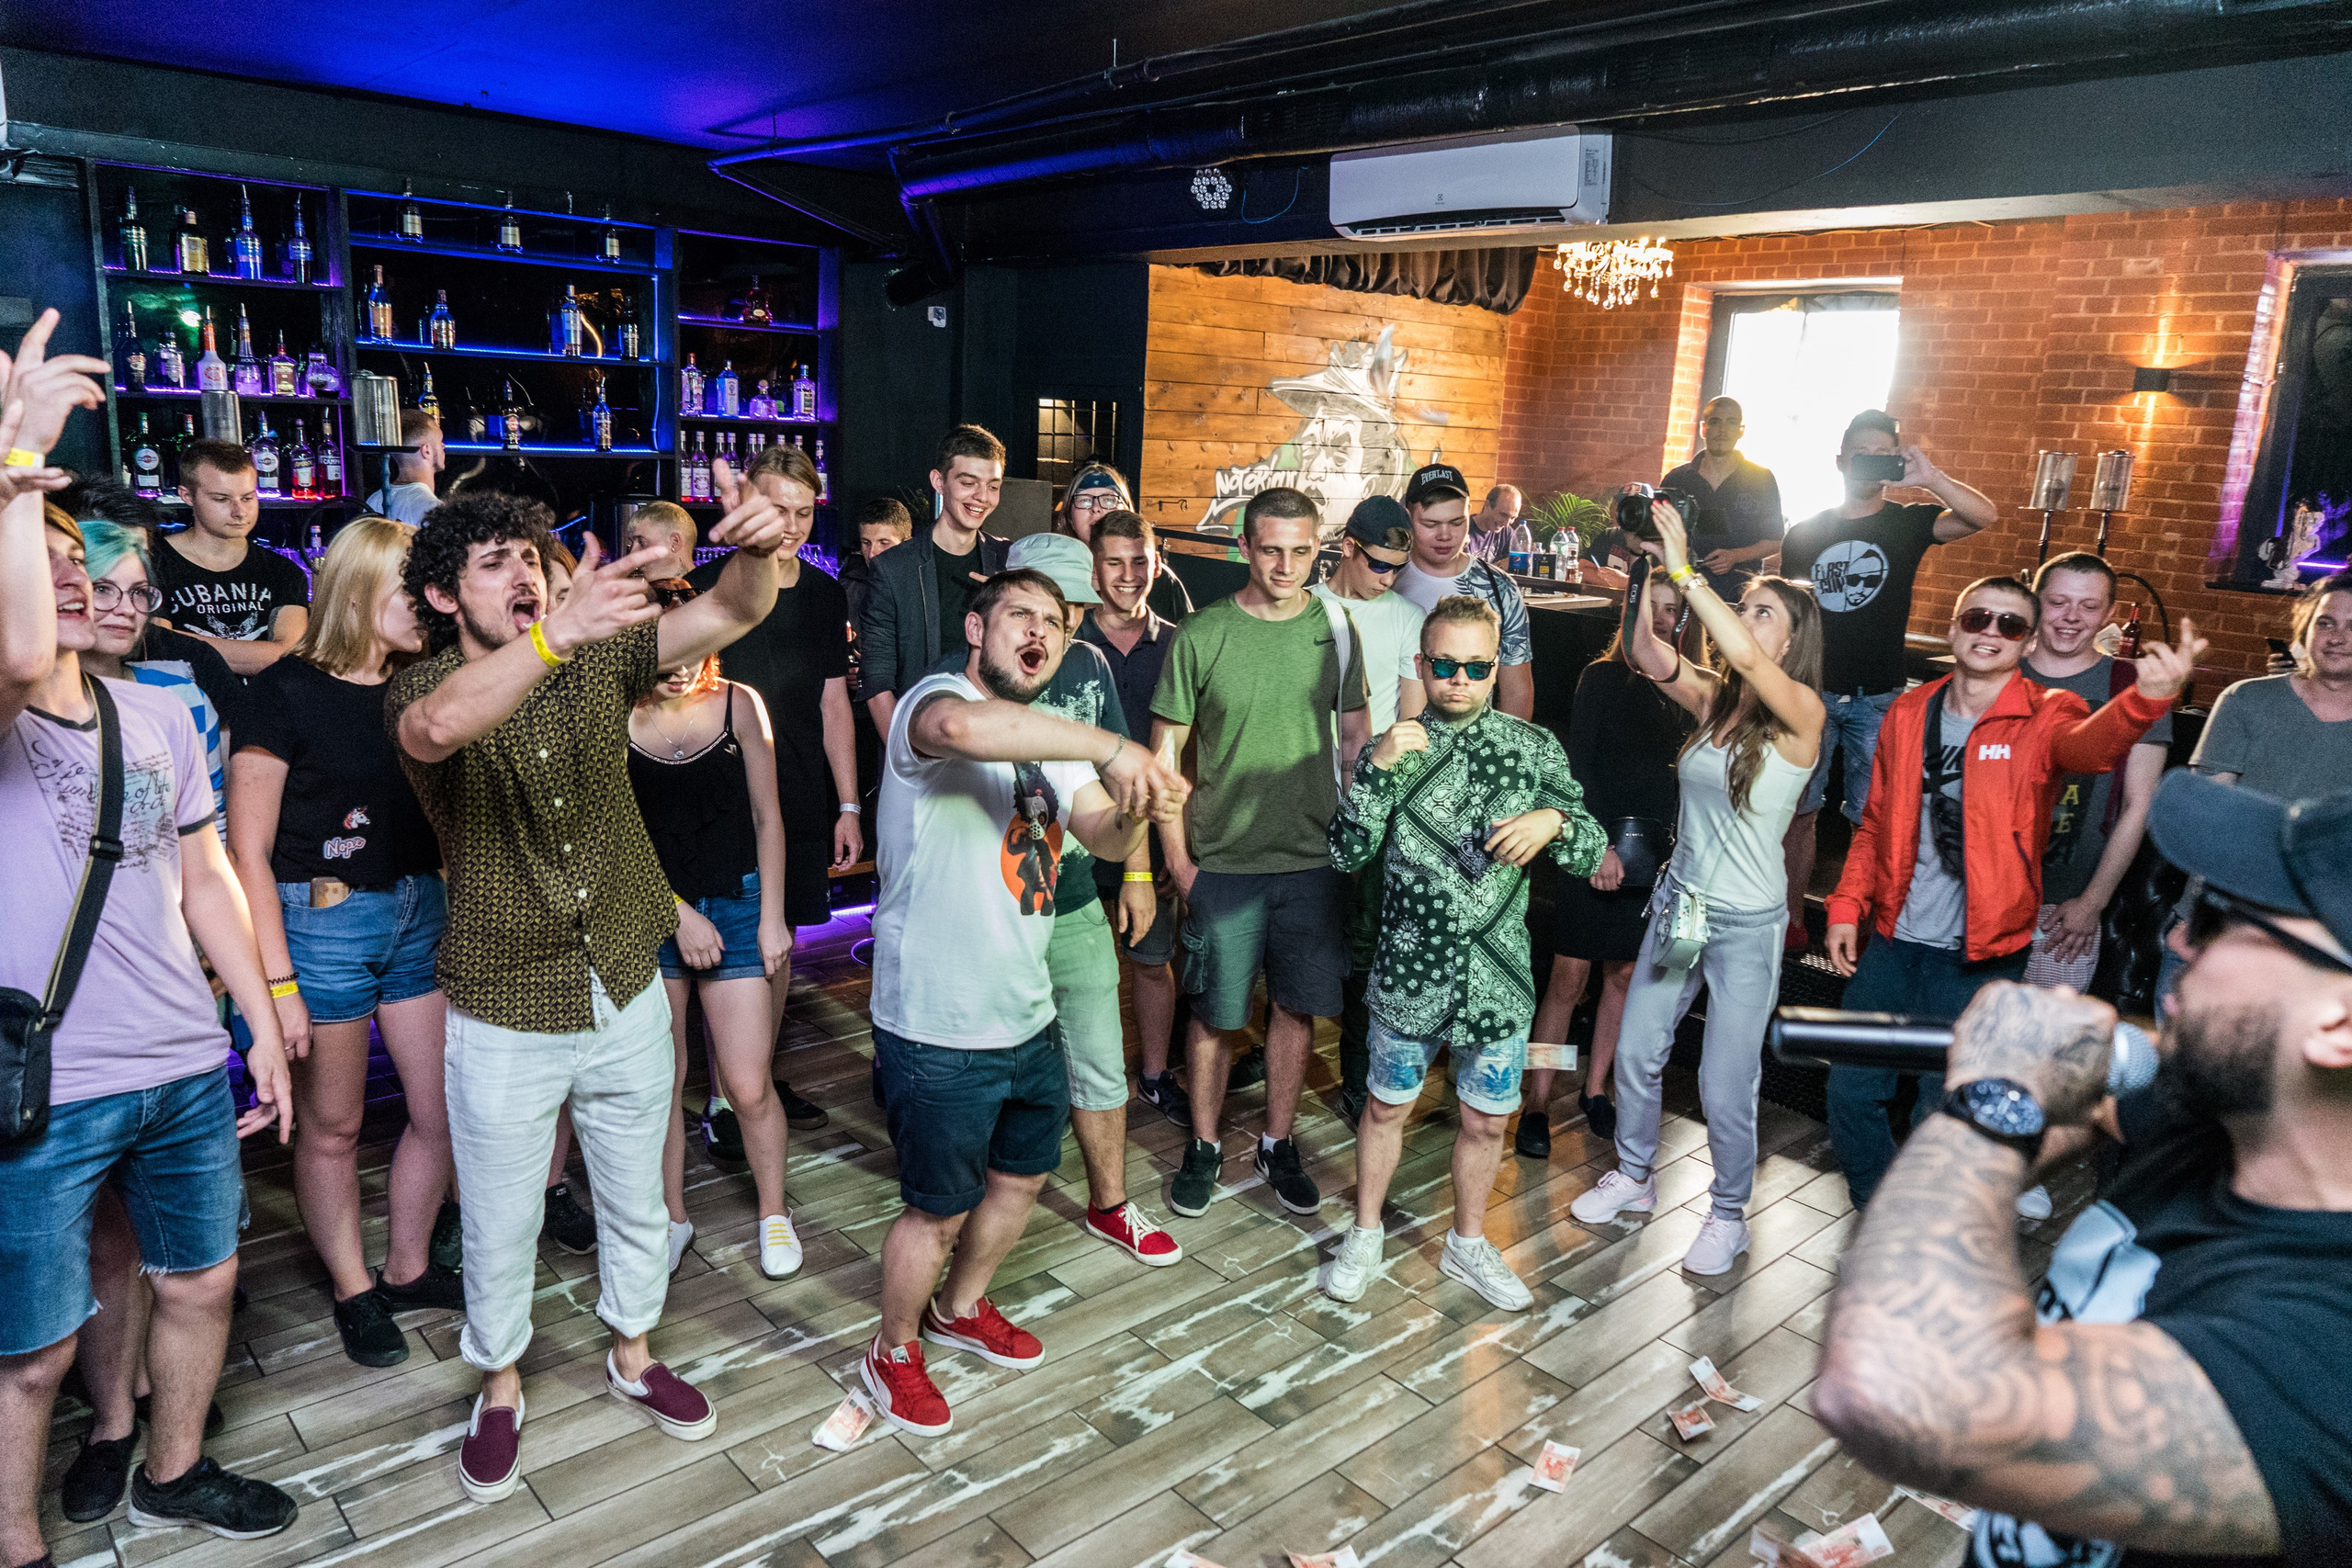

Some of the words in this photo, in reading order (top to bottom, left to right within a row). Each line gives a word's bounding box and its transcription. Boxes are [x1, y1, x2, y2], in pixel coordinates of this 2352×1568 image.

[1420, 469, 1453, 486] EVERLAST
[1629, 583, 1638, 604] EOS
[197, 602, 265, 615] ORIGINAL
[1978, 744, 2011, 761] HH
[322, 836, 367, 859] Nope
